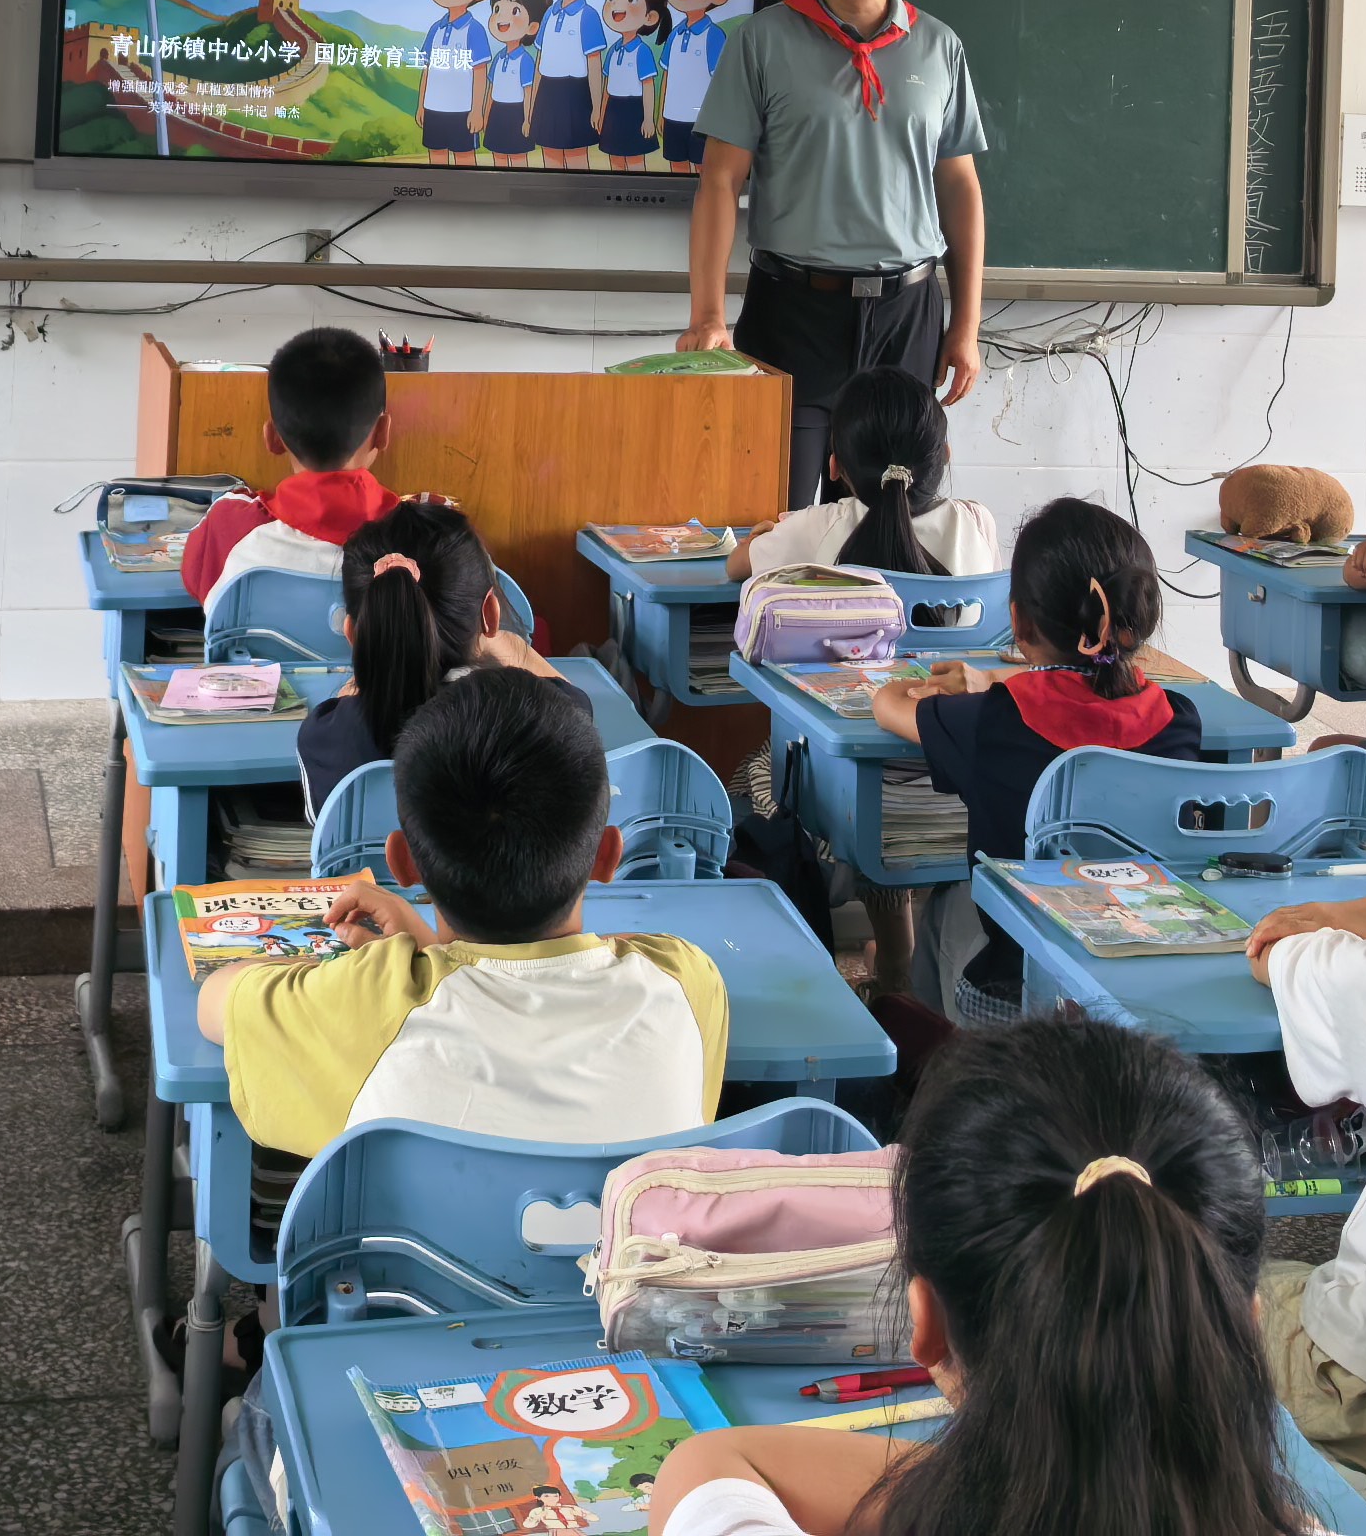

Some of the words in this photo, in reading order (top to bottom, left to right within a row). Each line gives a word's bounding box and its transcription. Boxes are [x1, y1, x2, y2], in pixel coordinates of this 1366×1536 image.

[109, 33, 301, 63] 青山桥镇中心小学
[314, 42, 475, 71] 国防教育主题课
[107, 79, 189, 96] 增强国防观念
[196, 82, 276, 99] 厚植爱国情怀
[393, 186, 433, 198] seewo
[203, 896, 334, 914] 课堂笔
[523, 1384, 620, 1419] 数学
[447, 1457, 524, 1481] 四年级
